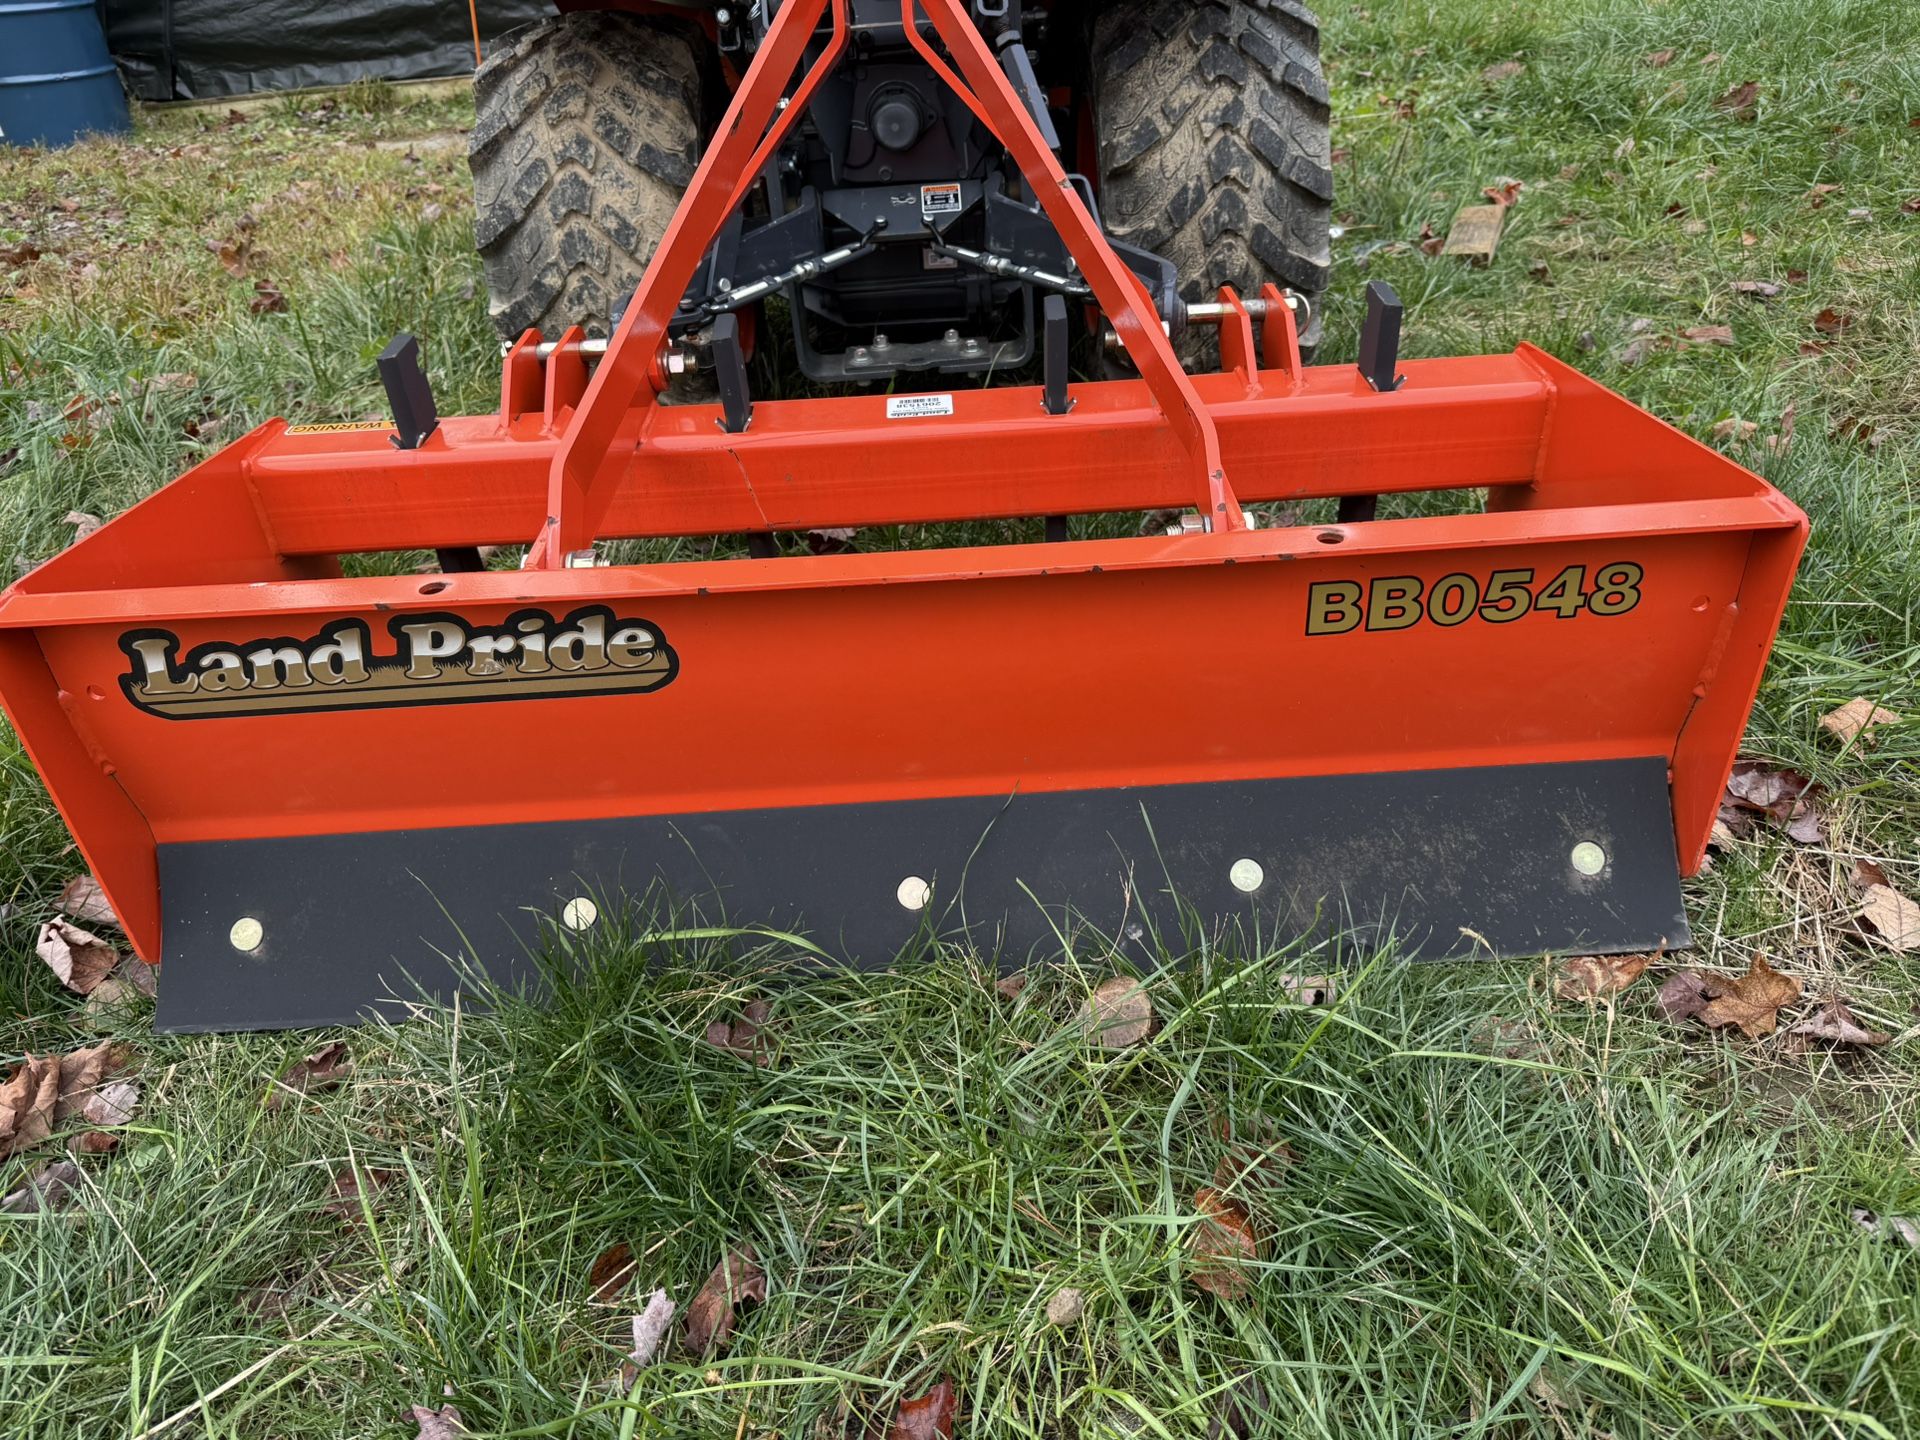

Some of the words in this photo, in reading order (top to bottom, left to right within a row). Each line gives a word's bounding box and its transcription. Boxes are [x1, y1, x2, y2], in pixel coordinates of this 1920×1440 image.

[292, 422, 382, 433] WARNING
[1305, 561, 1644, 637] BB0548
[131, 627, 369, 695] Land
[399, 613, 657, 679] Pride
